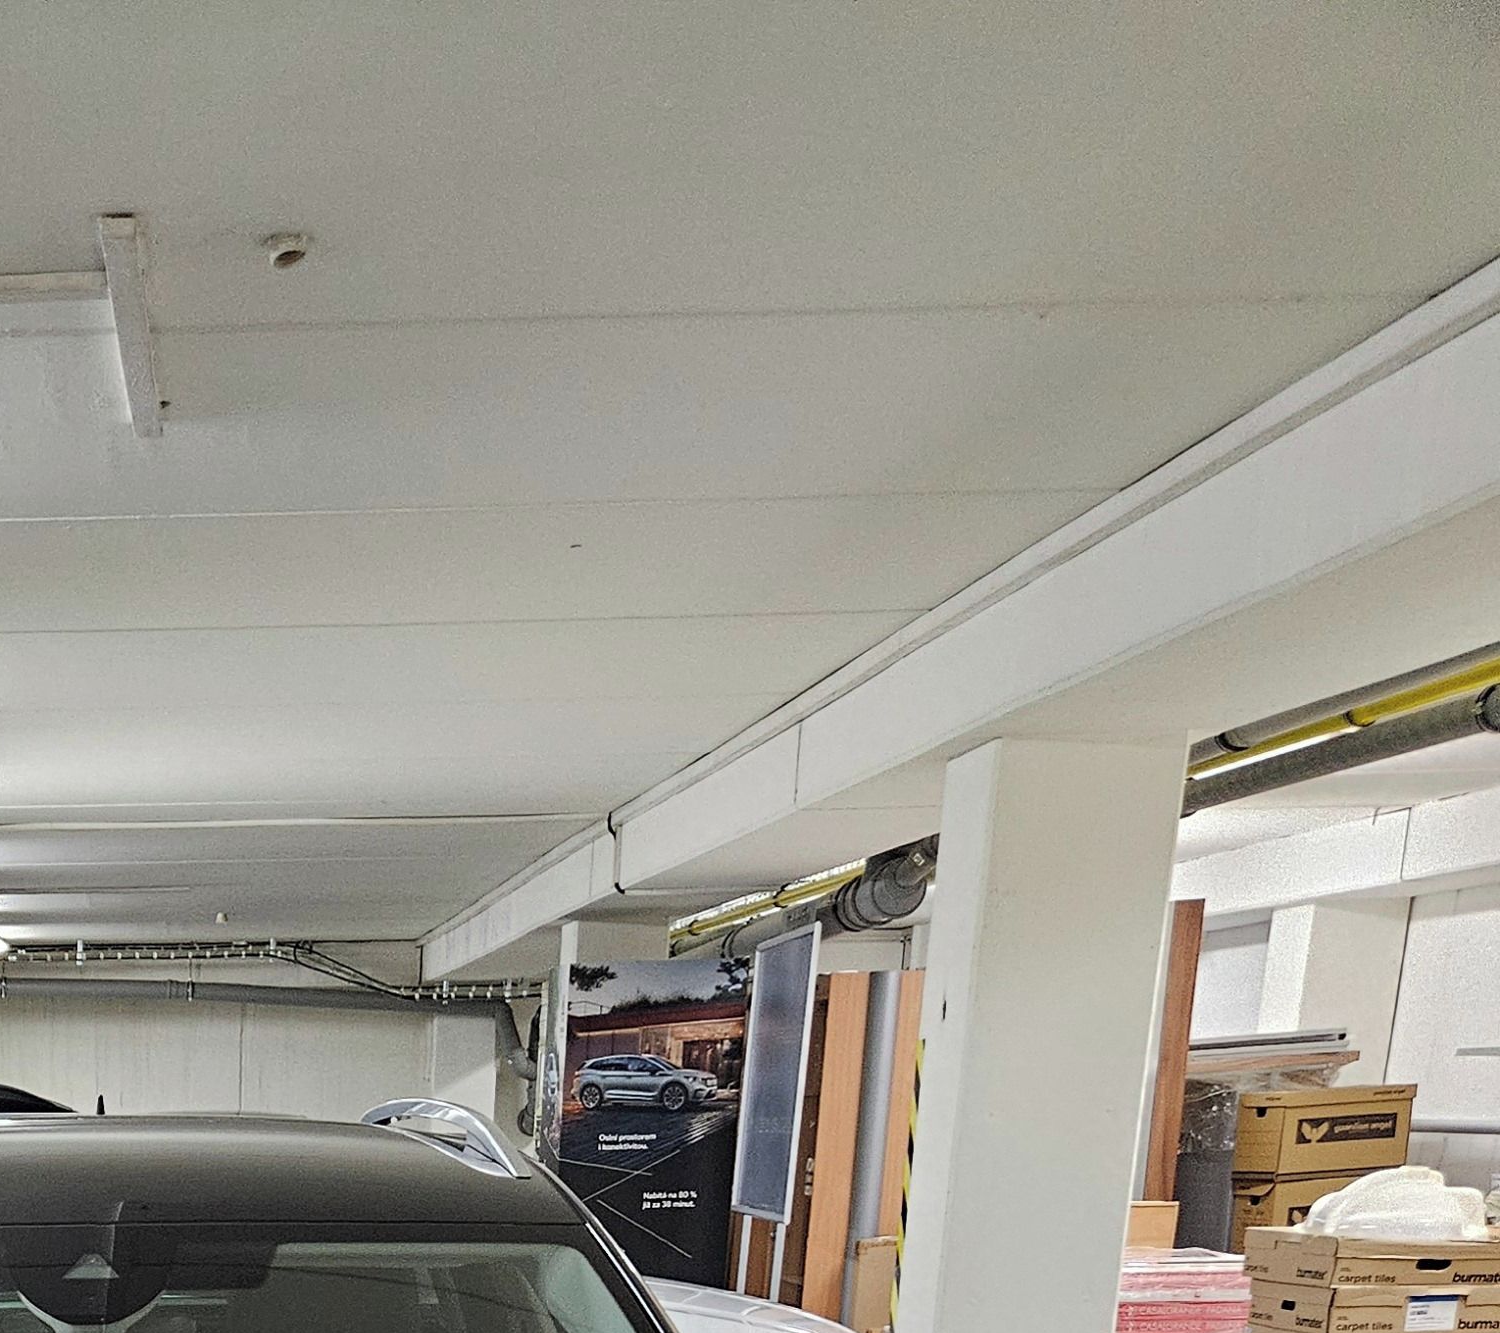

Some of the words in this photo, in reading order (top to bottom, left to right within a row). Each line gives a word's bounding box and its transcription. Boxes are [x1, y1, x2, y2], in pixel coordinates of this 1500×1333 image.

[1338, 1275, 1372, 1283] carpet
[1374, 1274, 1396, 1283] tiles
[1336, 1323, 1369, 1331] carpet
[1371, 1322, 1393, 1330] tiles
